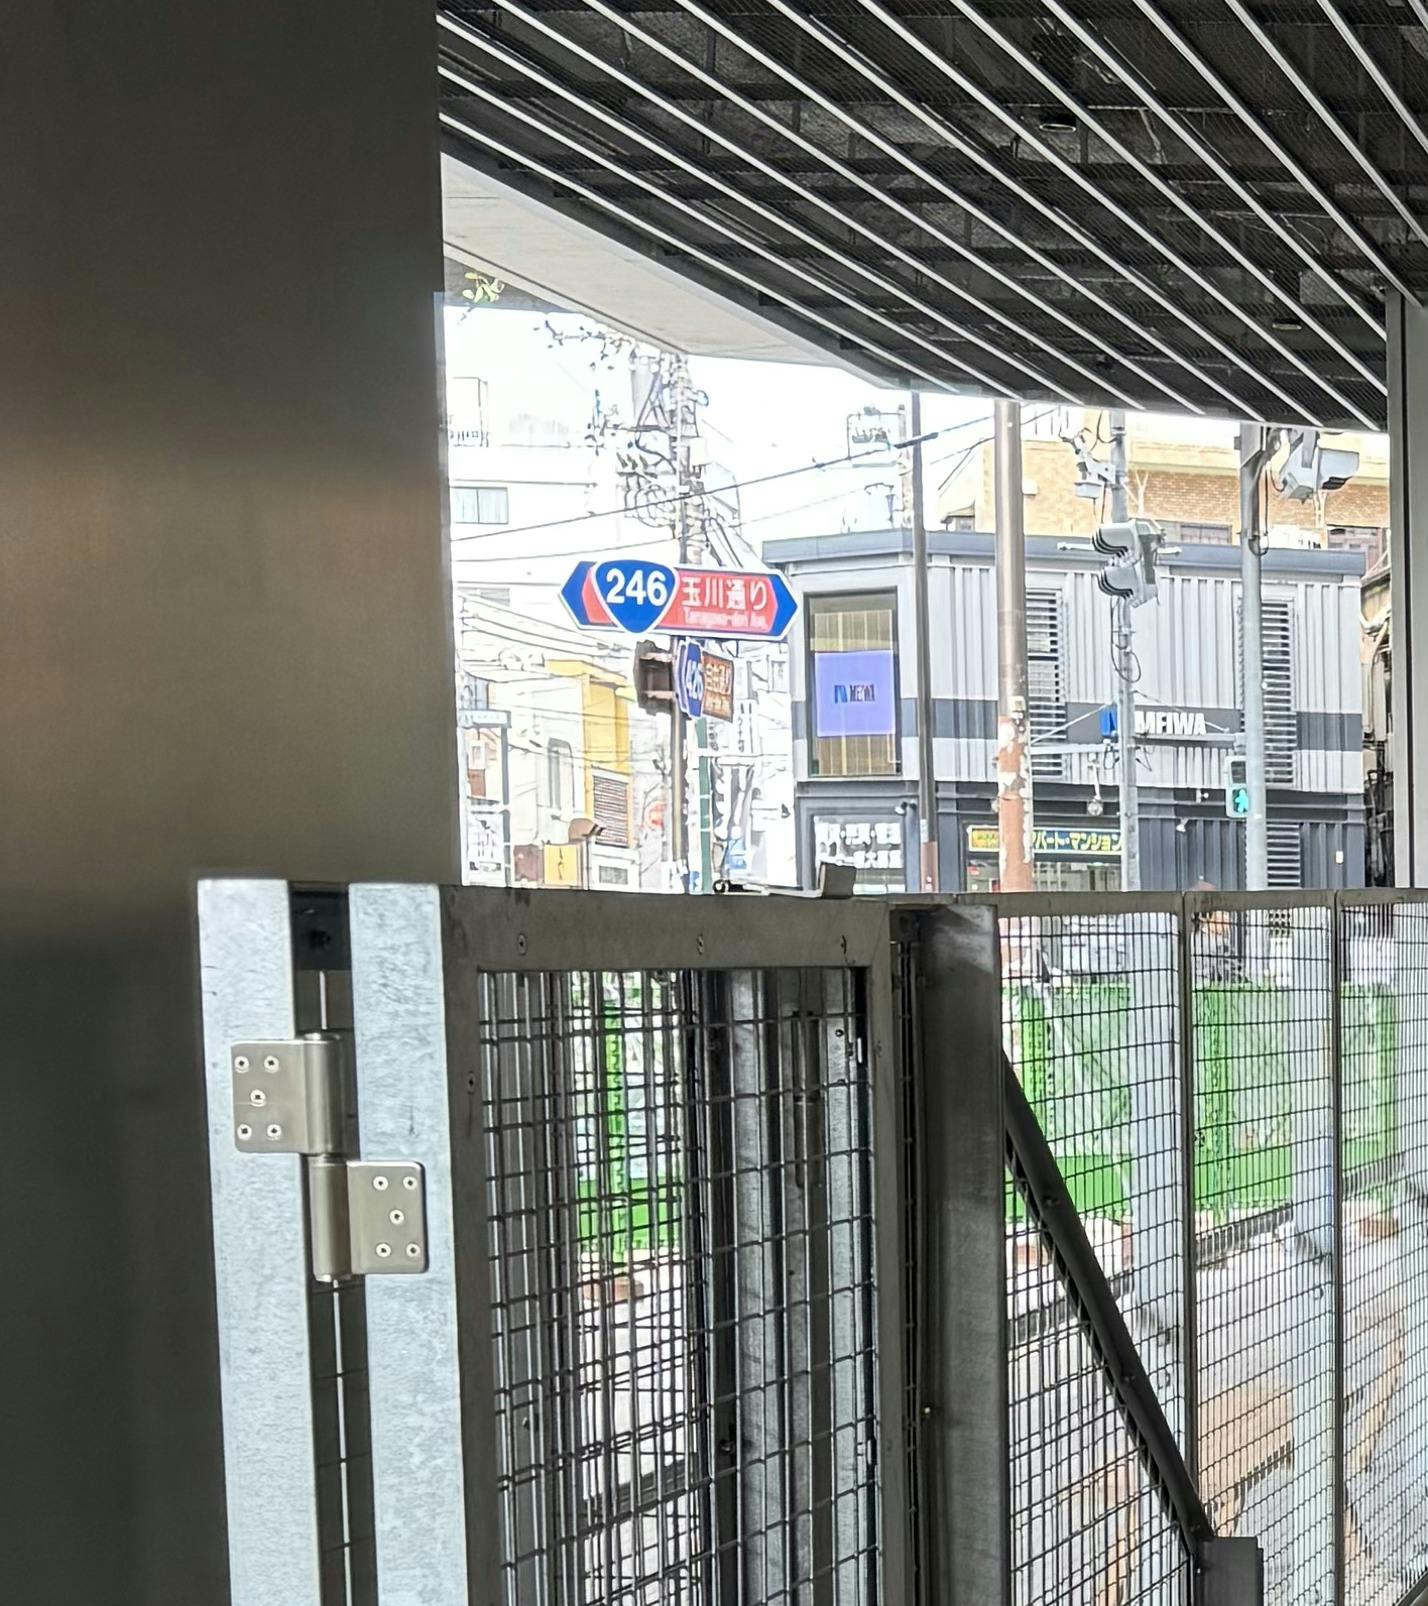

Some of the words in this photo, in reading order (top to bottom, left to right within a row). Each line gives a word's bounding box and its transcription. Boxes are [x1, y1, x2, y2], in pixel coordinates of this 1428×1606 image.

[606, 567, 668, 607] 246
[681, 576, 768, 612] 玉川通り
[1134, 711, 1206, 735] MEIWA
